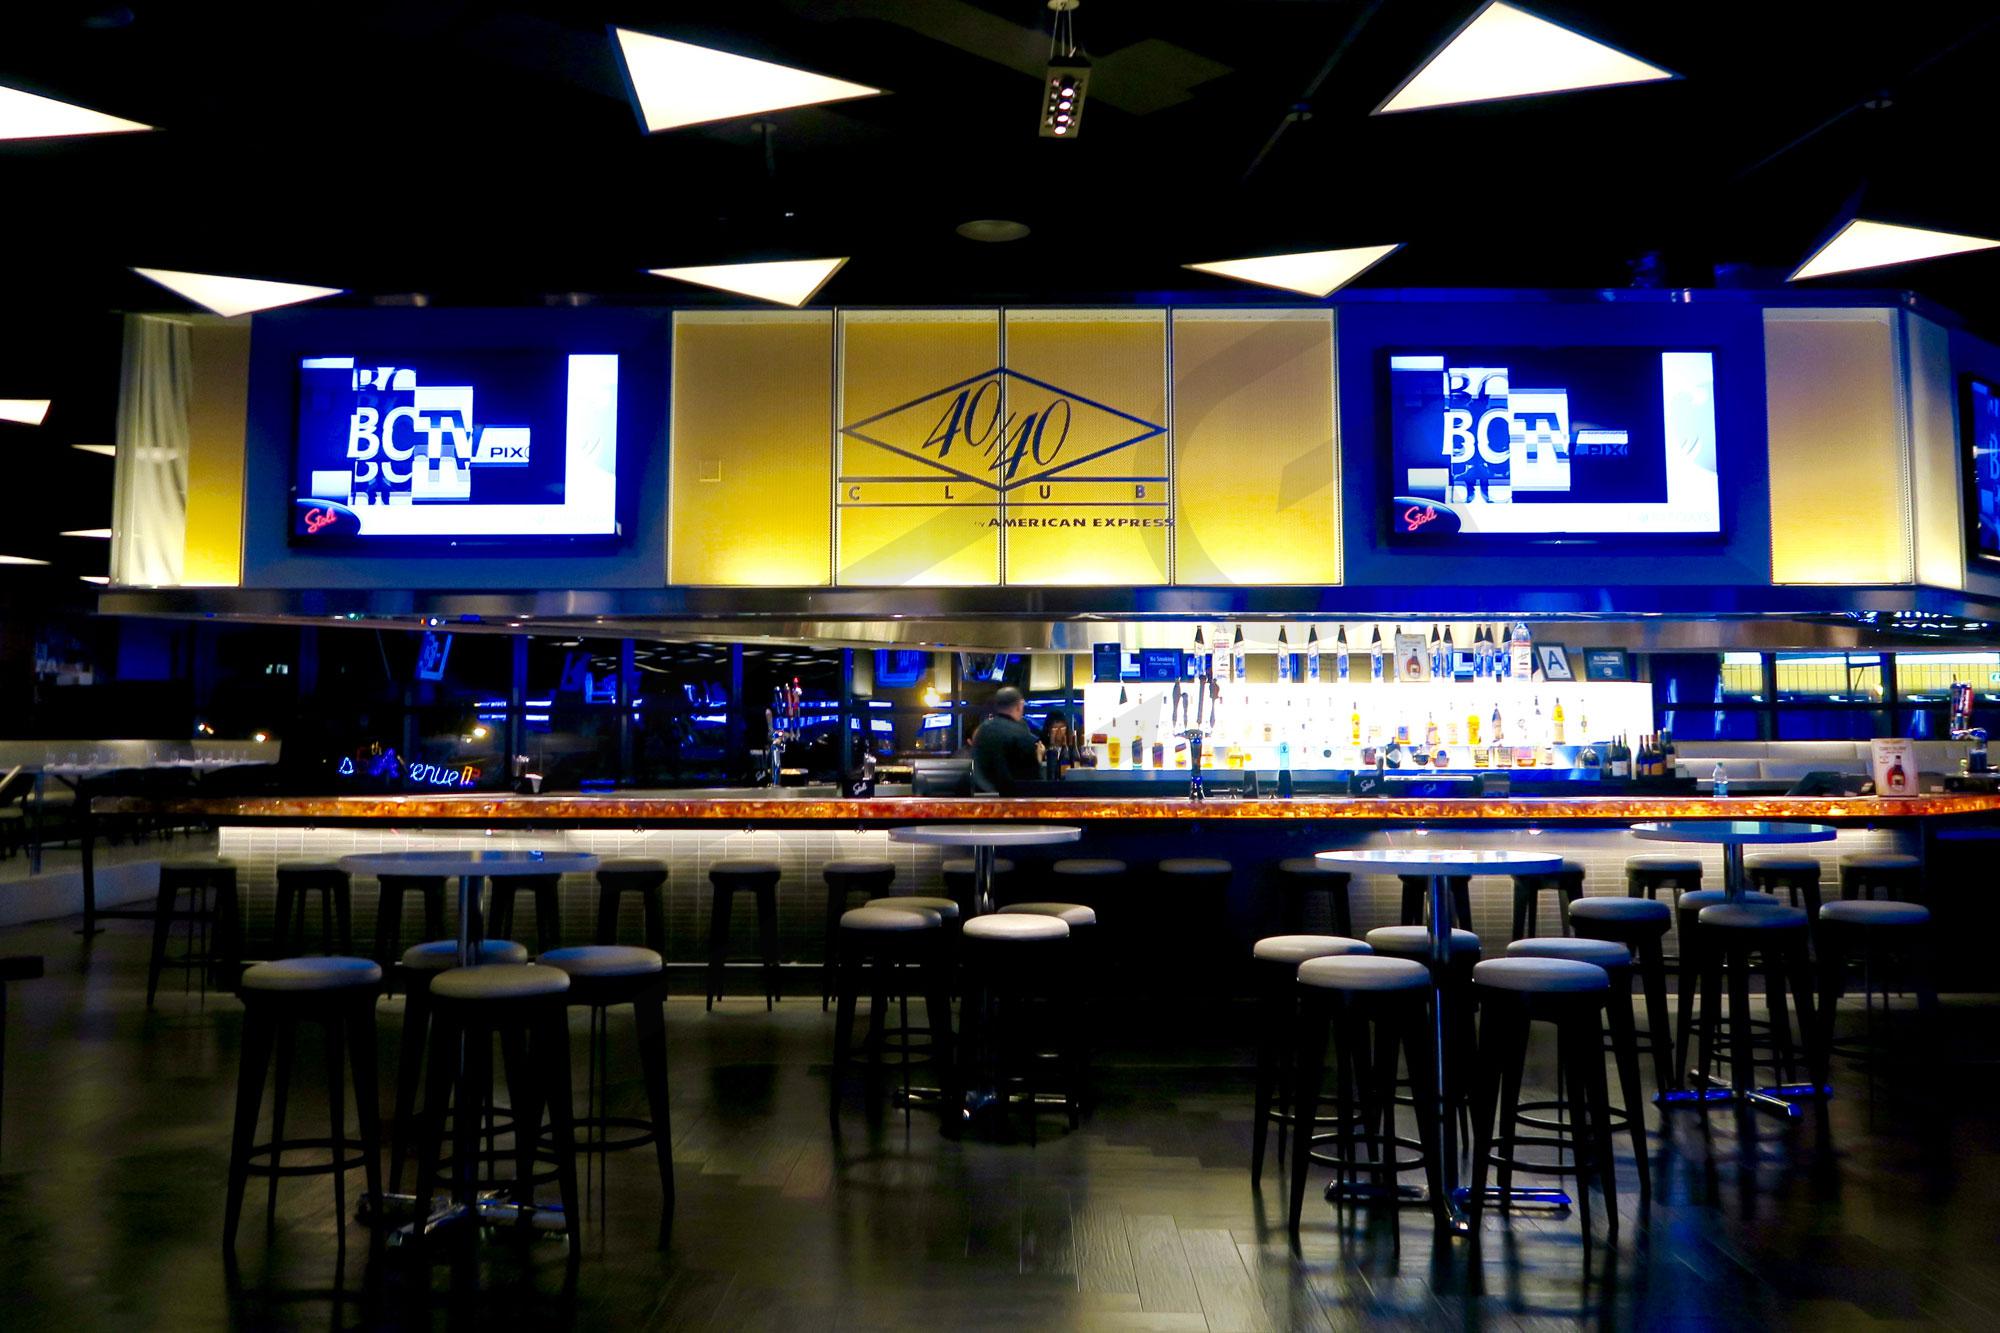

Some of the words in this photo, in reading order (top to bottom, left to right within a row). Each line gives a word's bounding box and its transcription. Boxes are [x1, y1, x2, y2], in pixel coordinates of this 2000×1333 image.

[987, 517, 1087, 528] AMERICAN
[1092, 517, 1176, 528] EXPRESS
[1547, 650, 1565, 671] A
